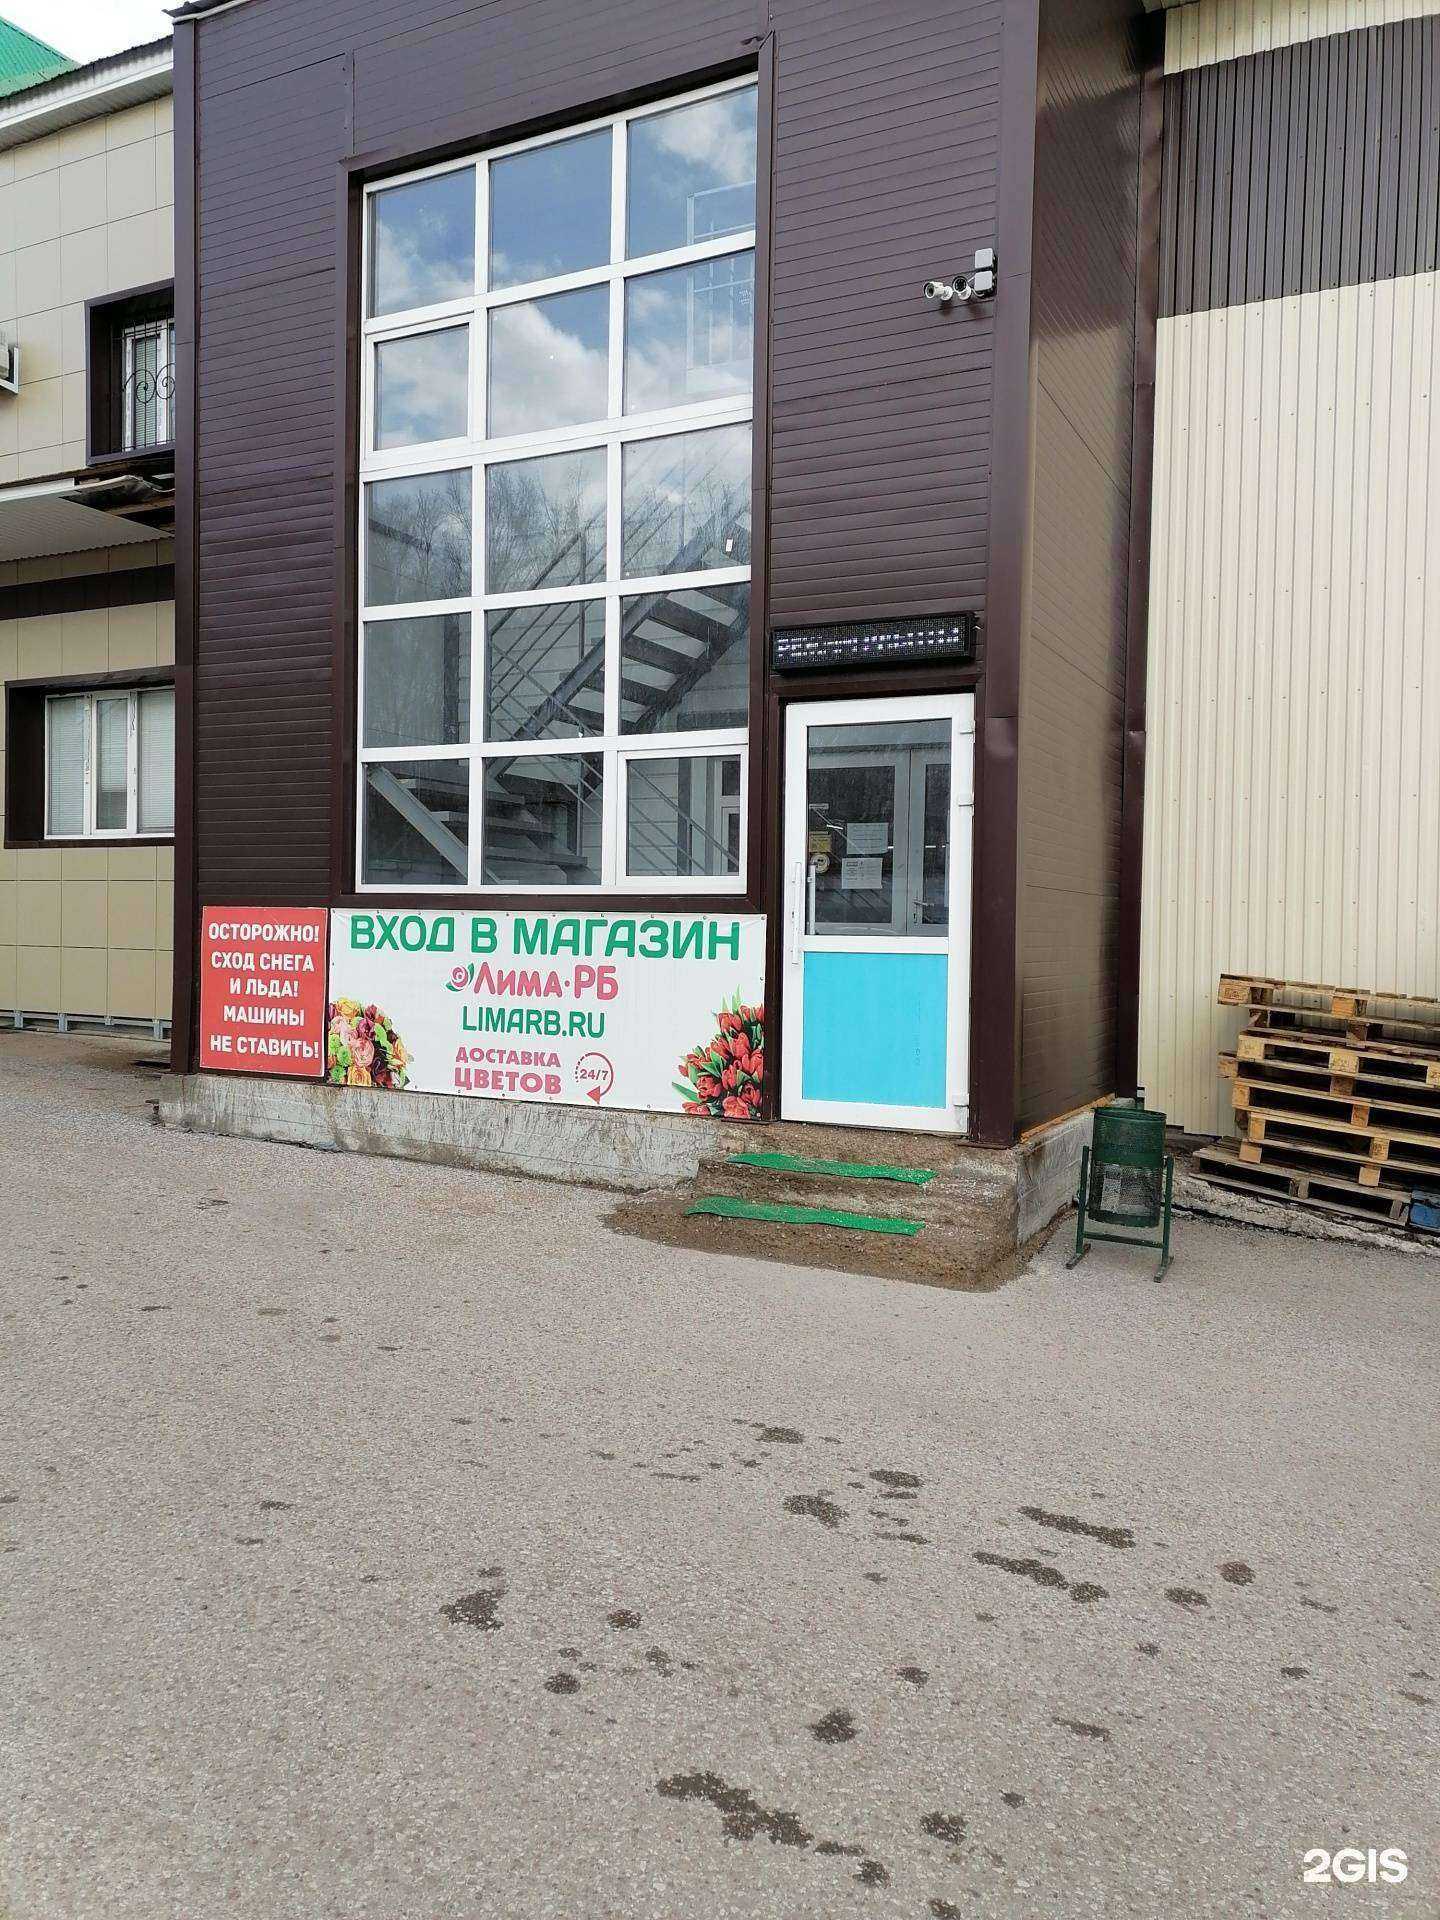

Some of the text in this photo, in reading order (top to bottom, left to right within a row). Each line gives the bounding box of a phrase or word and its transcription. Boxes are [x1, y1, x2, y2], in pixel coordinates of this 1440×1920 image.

[208, 922, 319, 943] ОСТОРОЖНО!
[350, 915, 740, 961] ВХОД В МАГАЗИН
[211, 951, 315, 972] СХОД СНЕГА
[229, 977, 299, 998] И ЛЬДА!
[223, 1005, 305, 1026] МАШИНЫ
[462, 1005, 605, 1038] LIMARB.RU
[210, 1035, 319, 1059] НЕ СТАВИТЬ!
[456, 1047, 560, 1067] ДОСТАВКА
[454, 1069, 562, 1095] ЦВЕТОВ
[579, 1068, 609, 1081] 24/7
